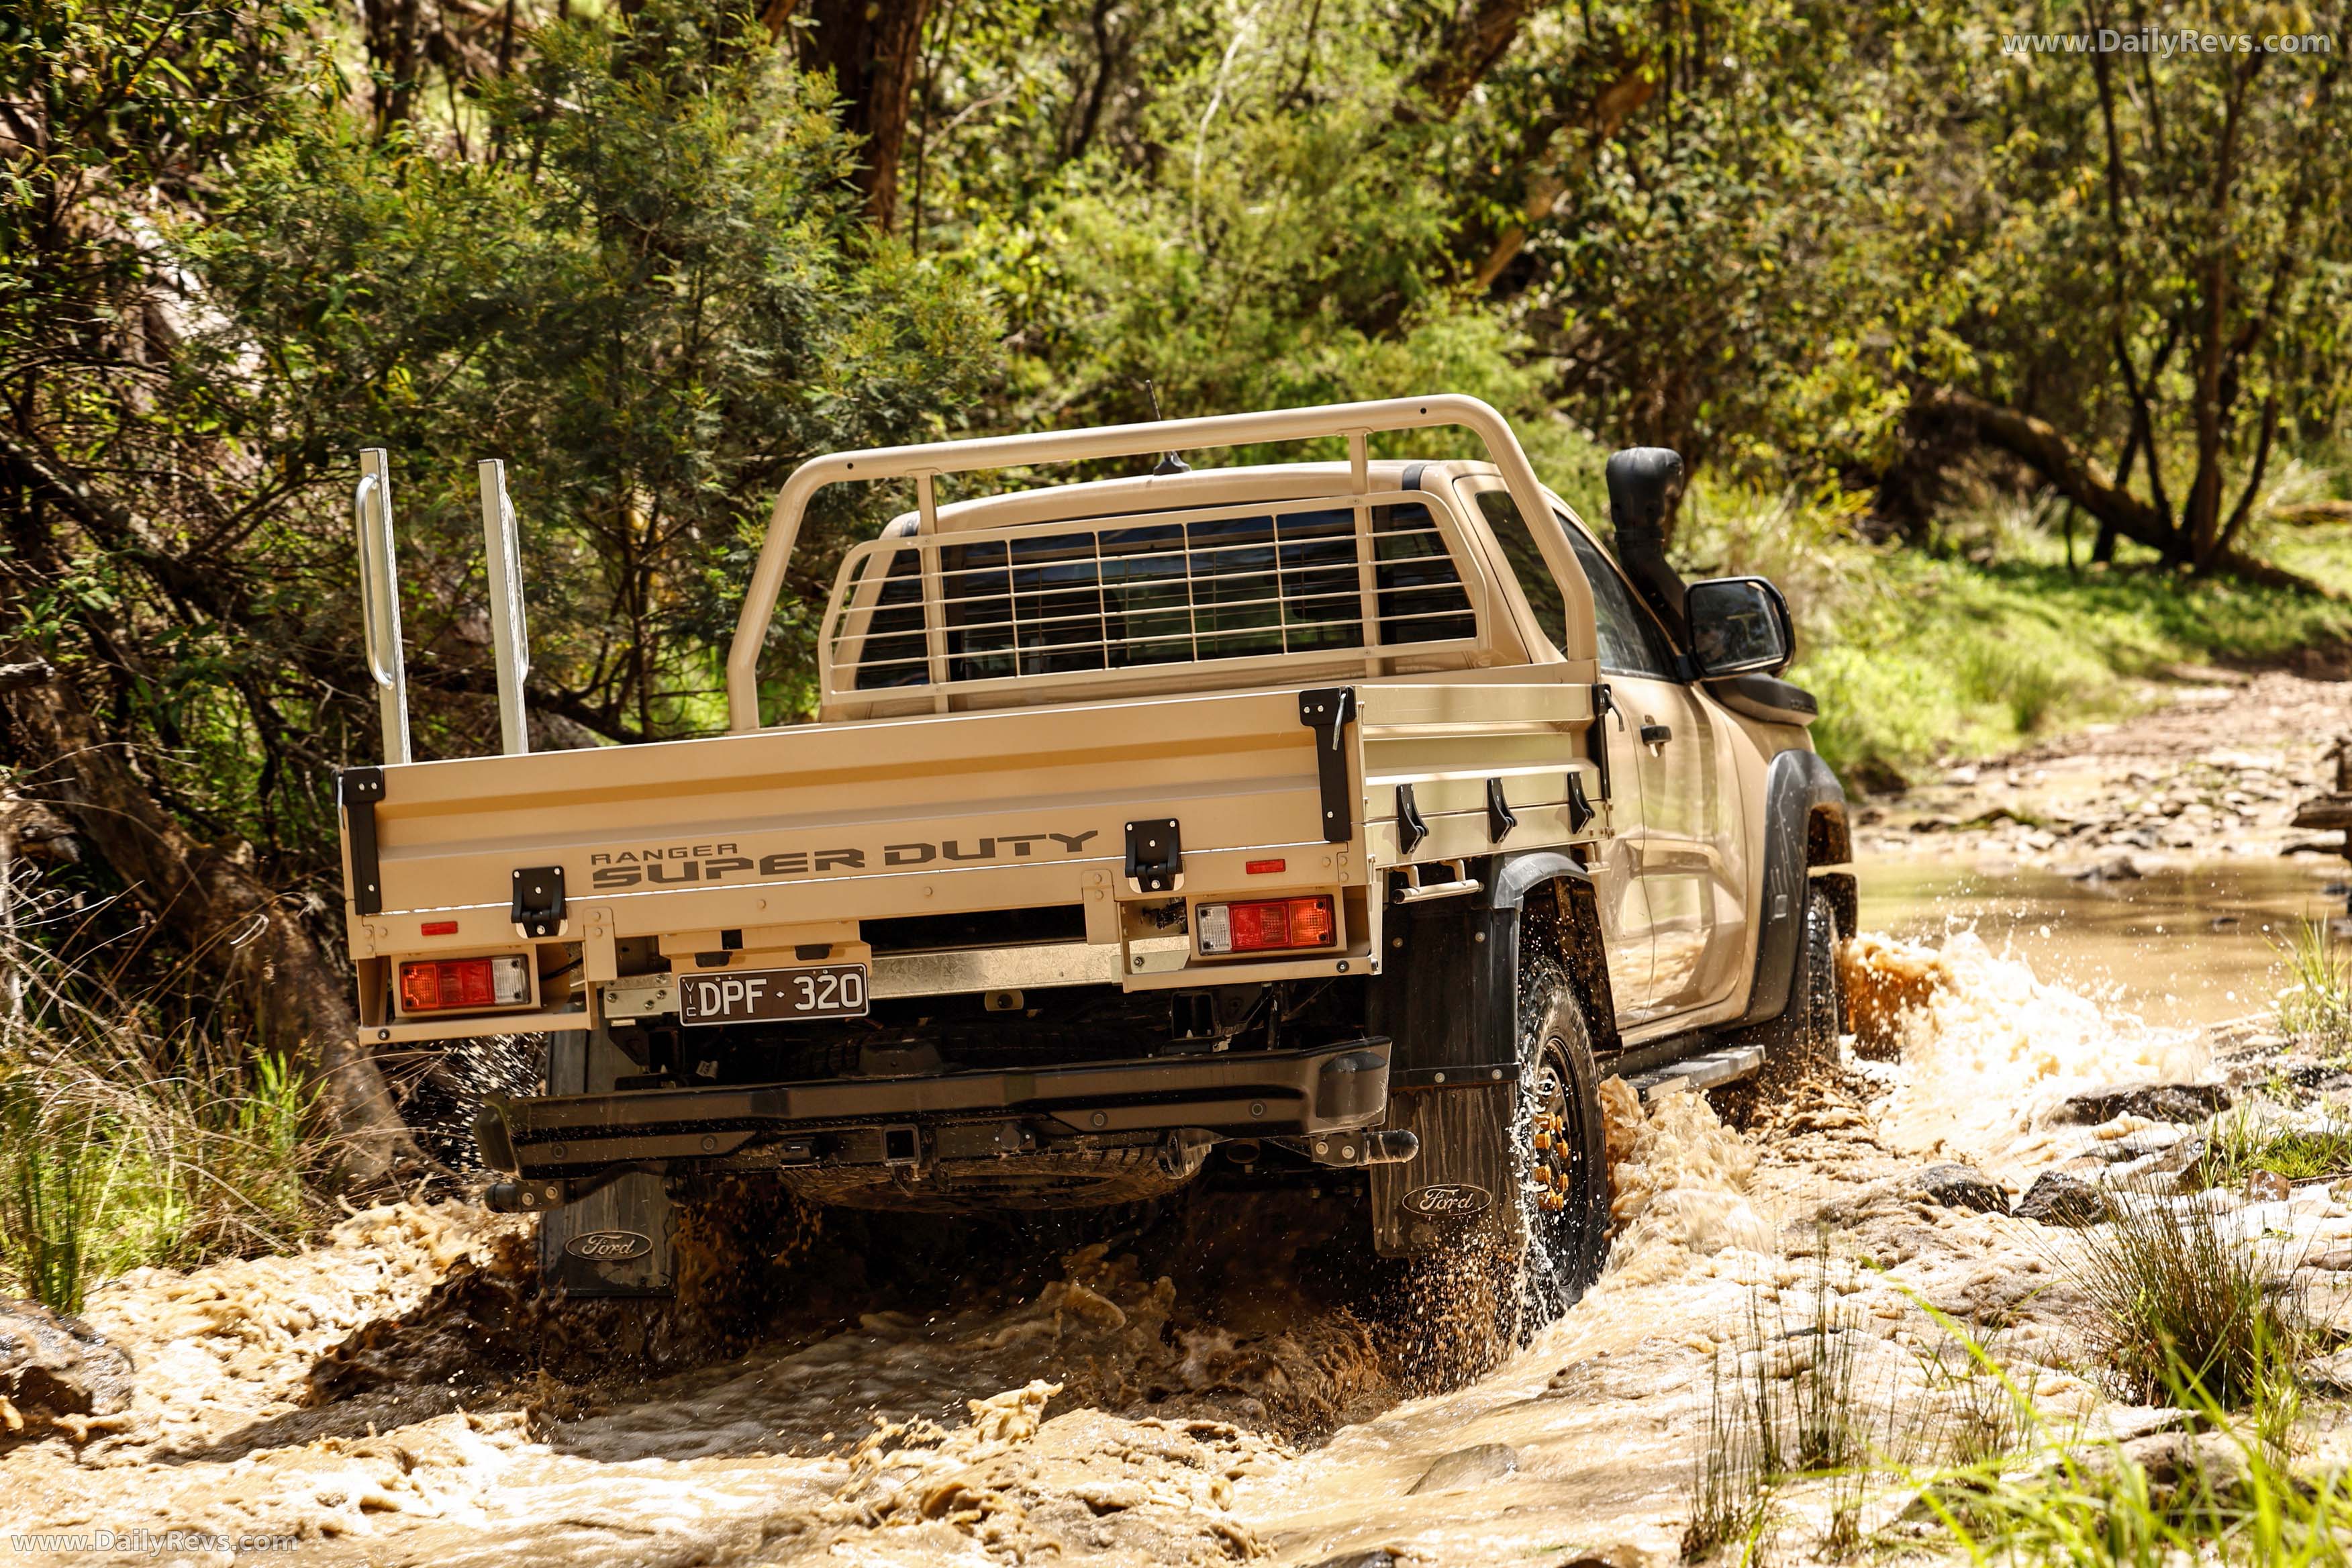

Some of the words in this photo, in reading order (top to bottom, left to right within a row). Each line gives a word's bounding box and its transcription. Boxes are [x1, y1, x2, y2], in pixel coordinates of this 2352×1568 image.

[591, 843, 738, 865] RANGER
[593, 848, 865, 889] SUPER
[884, 830, 1098, 866] DUTY
[685, 982, 697, 1017] VIC
[698, 978, 767, 1016] DPF
[793, 973, 863, 1010] 320
